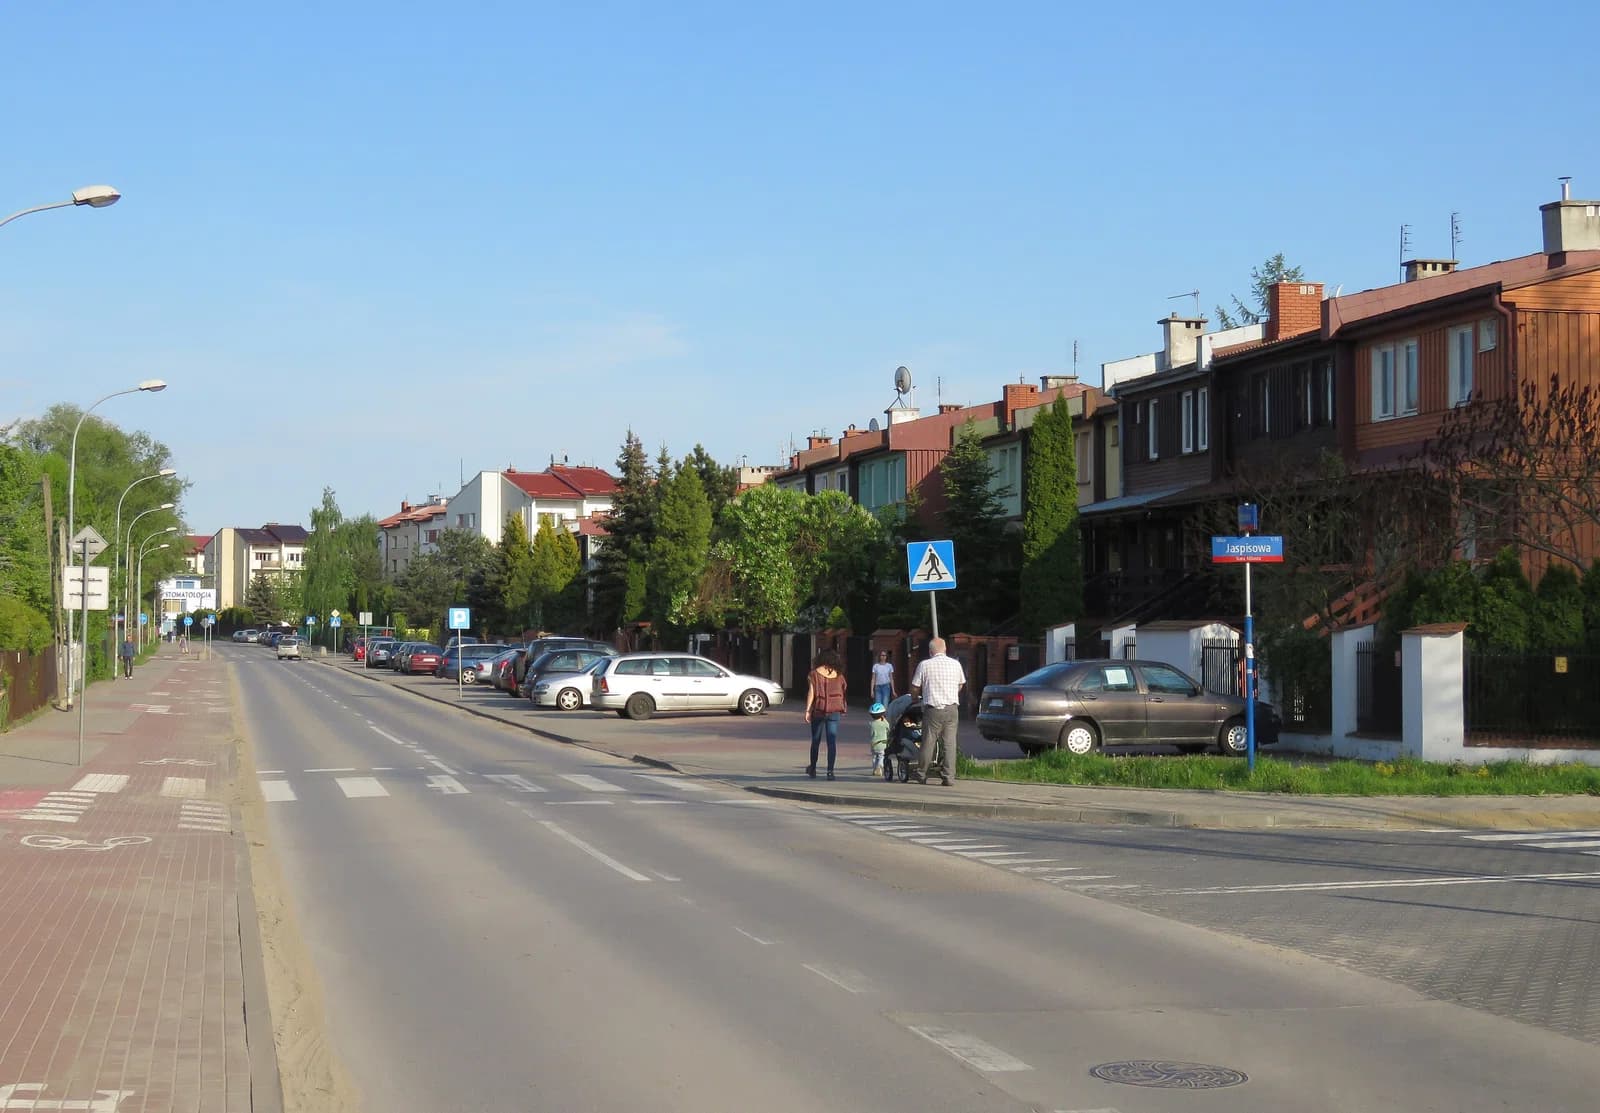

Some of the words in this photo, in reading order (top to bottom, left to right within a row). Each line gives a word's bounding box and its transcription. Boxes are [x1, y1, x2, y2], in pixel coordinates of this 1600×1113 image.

[1225, 543, 1271, 555] Jaspisowa
[165, 591, 212, 599] STOMATOLOGIA
[454, 611, 467, 626] P
